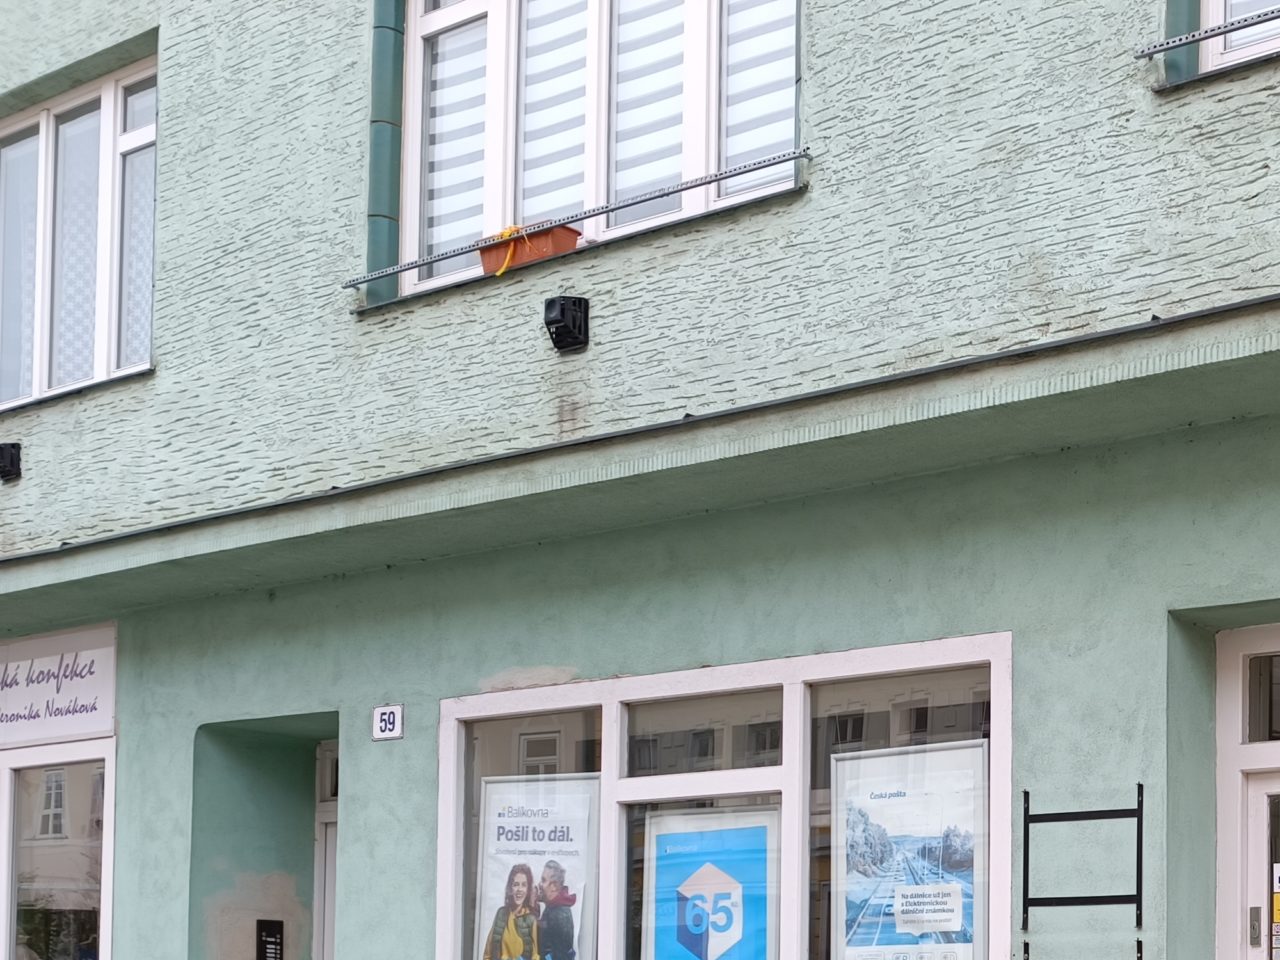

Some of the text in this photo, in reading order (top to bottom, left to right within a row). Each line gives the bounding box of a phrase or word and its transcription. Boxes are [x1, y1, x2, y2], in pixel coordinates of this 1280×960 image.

[25, 651, 95, 694] konfekce
[44, 696, 98, 719] Nováková
[379, 710, 396, 733] 59
[496, 825, 574, 842] Pošli to dál.
[685, 893, 734, 935] 65
